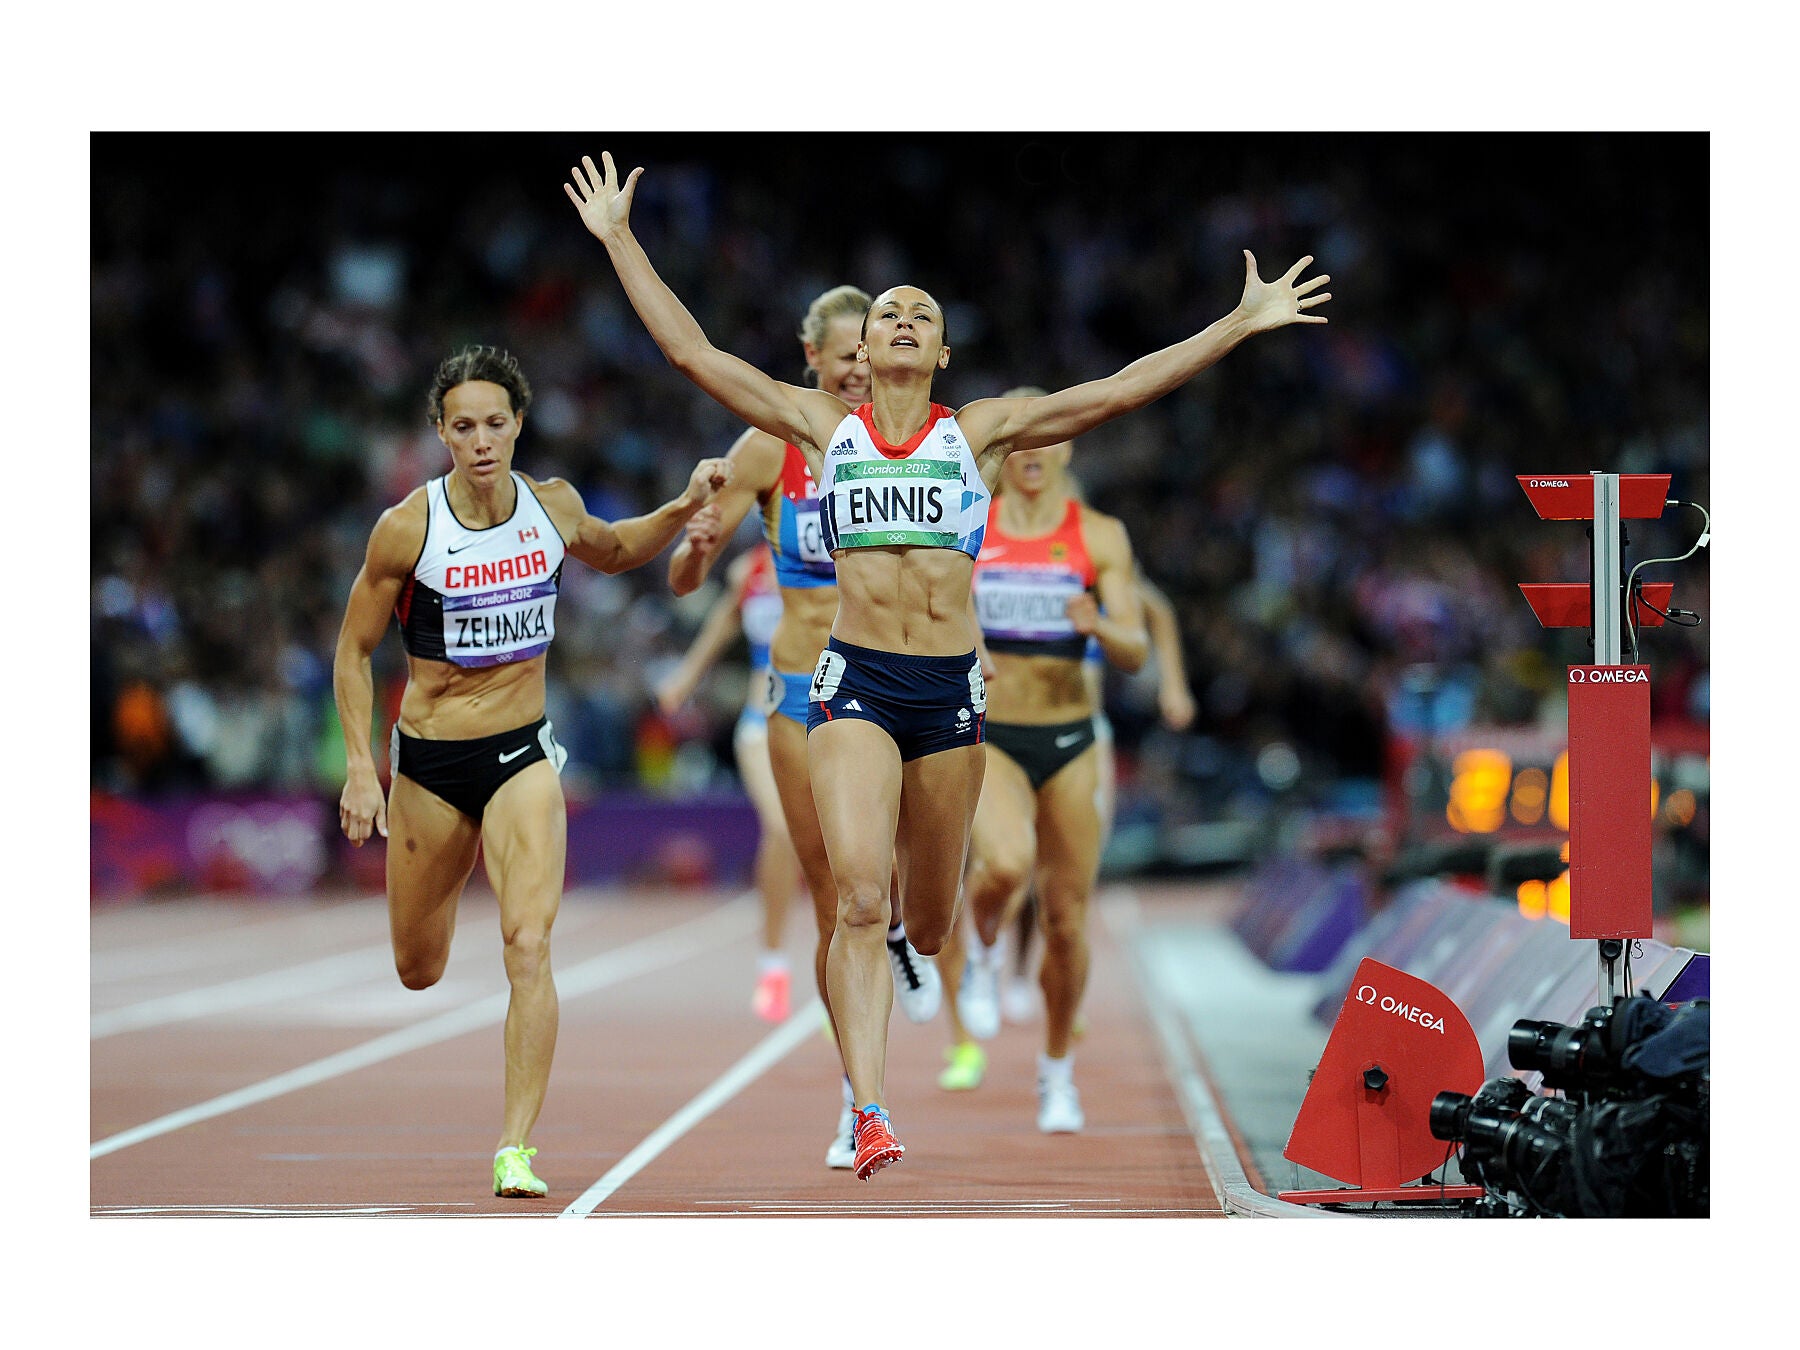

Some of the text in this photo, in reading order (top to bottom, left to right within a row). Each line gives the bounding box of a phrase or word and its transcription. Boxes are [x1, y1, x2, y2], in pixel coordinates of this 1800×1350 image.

[831, 447, 858, 456] adidas
[862, 463, 931, 475] London 2012
[1539, 480, 1569, 488] OMEGA
[850, 486, 943, 525] ENNIS
[445, 550, 548, 589] CANADA
[472, 588, 533, 608] London 2012
[455, 605, 548, 648] ZELINKA
[1589, 669, 1648, 683] OMEGA
[1380, 996, 1445, 1034] OMEGA
